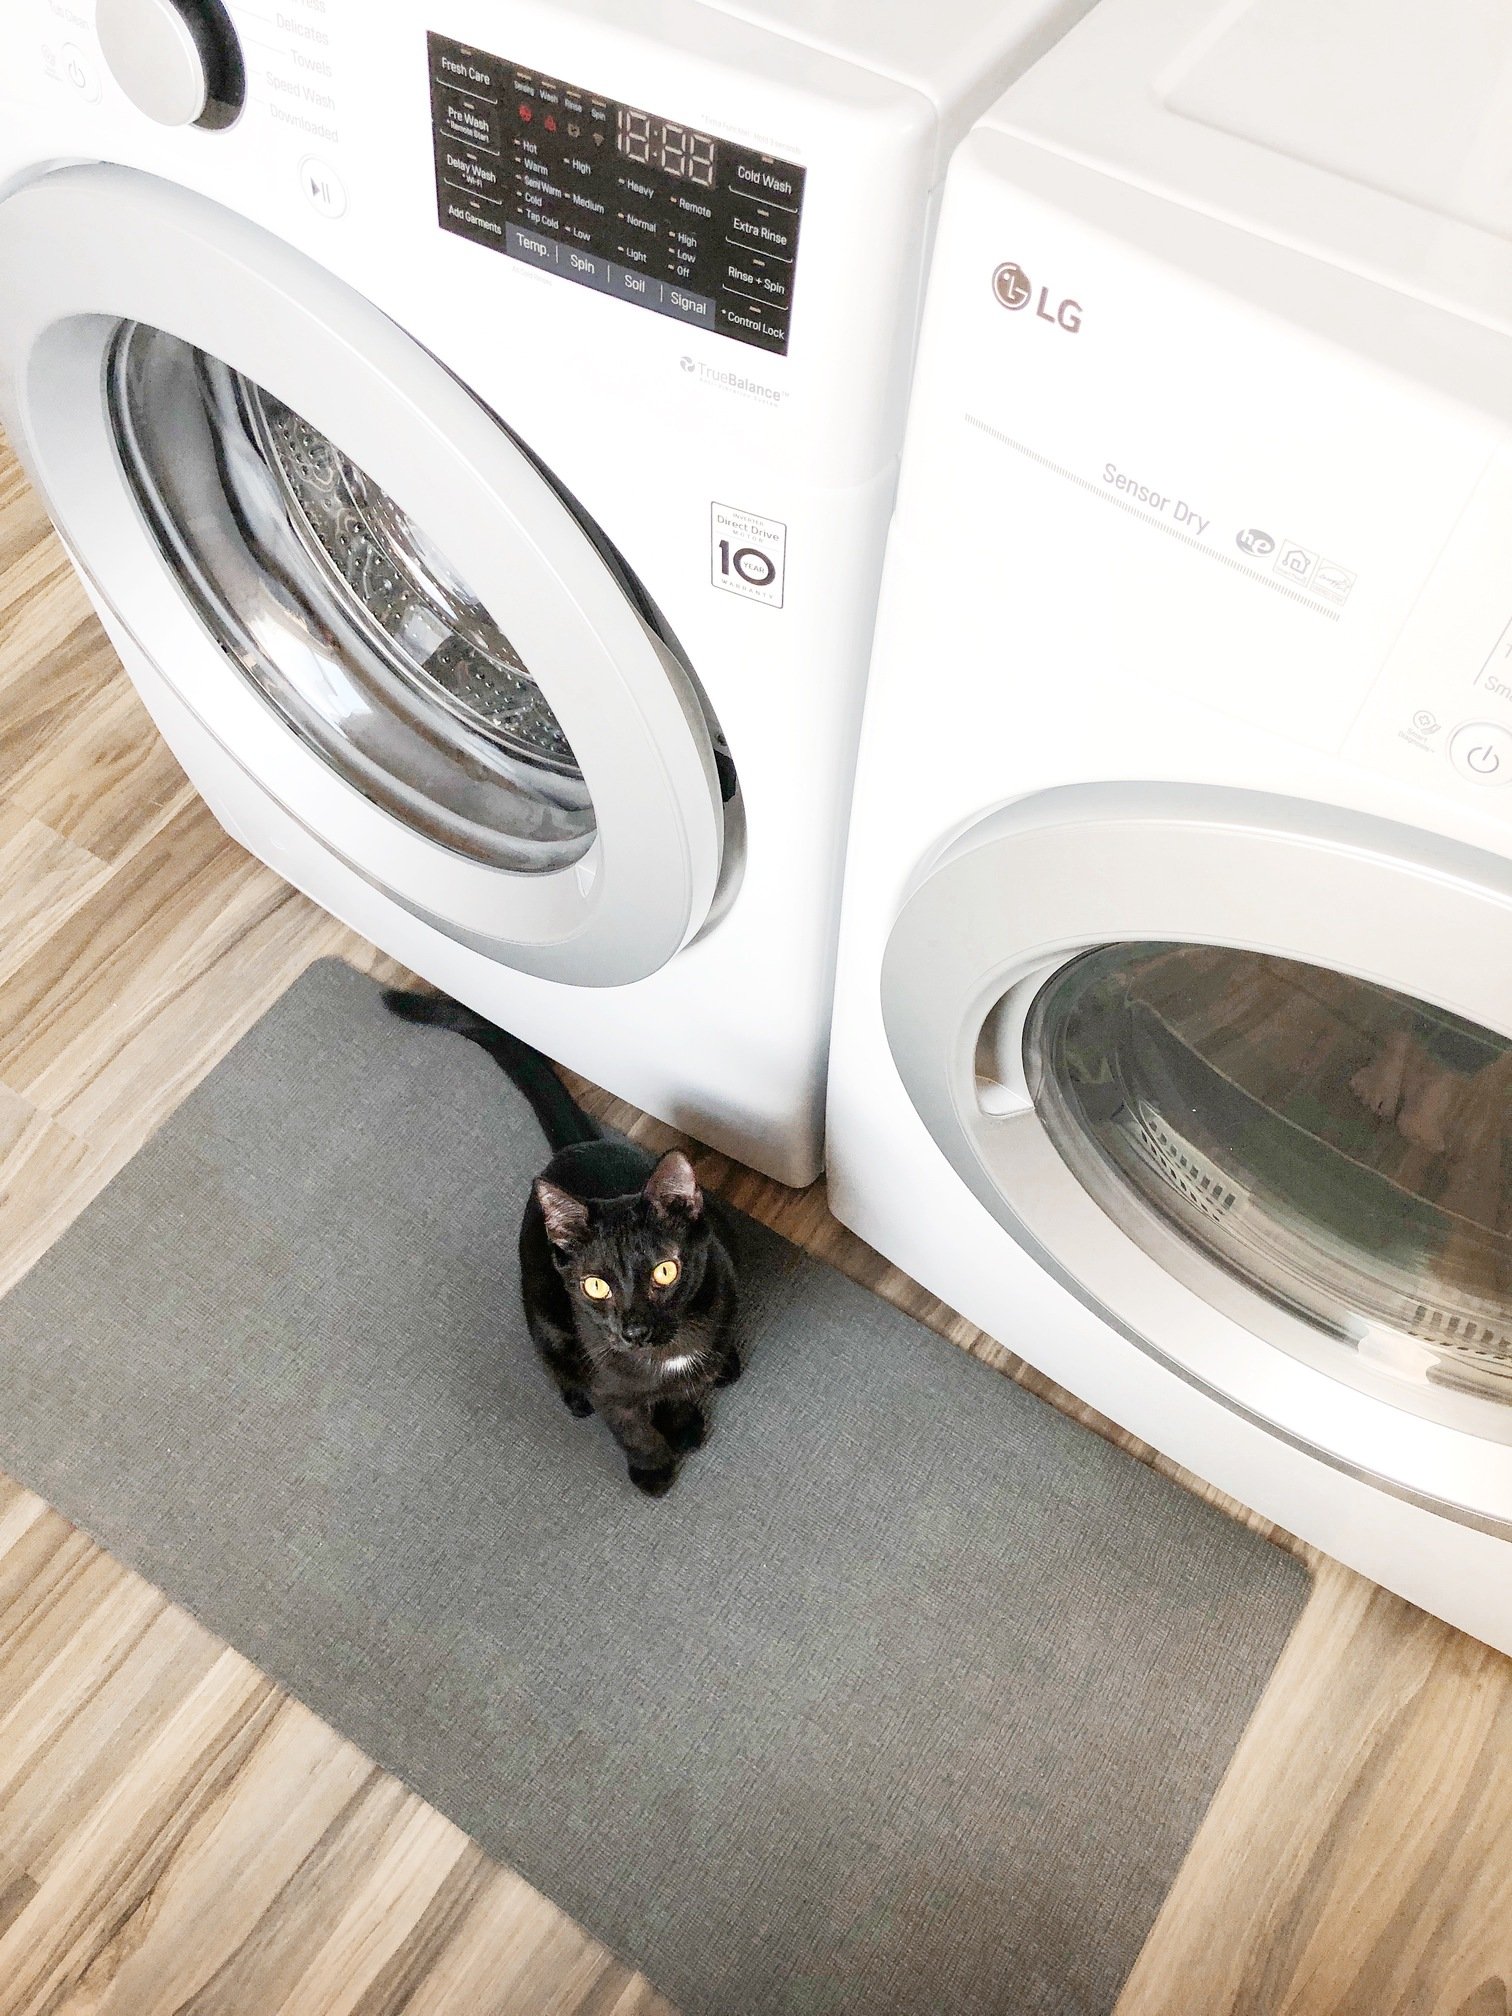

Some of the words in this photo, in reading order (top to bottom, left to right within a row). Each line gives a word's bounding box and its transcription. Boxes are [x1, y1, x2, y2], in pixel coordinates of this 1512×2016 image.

[276, 12, 329, 46] Delicates
[290, 48, 333, 78] Towels
[442, 56, 467, 77] Fresh
[468, 67, 491, 86] Care
[266, 71, 300, 97] Speed
[302, 86, 335, 111] Wash
[270, 103, 338, 143] Downloaded
[448, 105, 463, 122] Pre
[464, 112, 489, 132] Wash
[523, 140, 537, 155] Hot
[447, 153, 470, 174] Delay
[471, 164, 496, 183] Wash
[524, 158, 548, 176] Warm
[572, 158, 591, 175] High
[541, 181, 562, 198] Warm
[627, 178, 654, 199] Heavy
[738, 165, 760, 184] Cold
[761, 173, 792, 195] Wash
[525, 192, 542, 207] Cold
[573, 193, 605, 215] Medium
[679, 198, 712, 218] Remote
[449, 204, 464, 219] Add
[464, 212, 502, 235] Garments
[526, 208, 540, 224] Tap
[541, 215, 559, 229] Cold
[626, 213, 657, 233] Normal
[573, 228, 592, 241] Low
[678, 232, 697, 248] High
[733, 218, 759, 236] Extra
[760, 227, 787, 246] Rinse
[516, 232, 550, 257] Temp.
[626, 247, 647, 263] Light
[570, 254, 595, 274] Spin
[677, 249, 696, 264] Low
[677, 265, 690, 278] Off
[728, 266, 754, 285] Rinse
[764, 278, 785, 295] Spin
[624, 274, 645, 293] Soil
[671, 291, 707, 315] Signal
[1036, 285, 1084, 334] LG
[728, 311, 761, 332] Control
[763, 323, 785, 341] Lock
[1102, 462, 1171, 512] Sensor
[1172, 500, 1211, 536] Dry
[717, 514, 749, 532] Direct
[751, 525, 780, 542] Drive
[719, 538, 776, 587] 10
[743, 560, 766, 574] YEAR
[721, 578, 773, 600] WARRANTY
